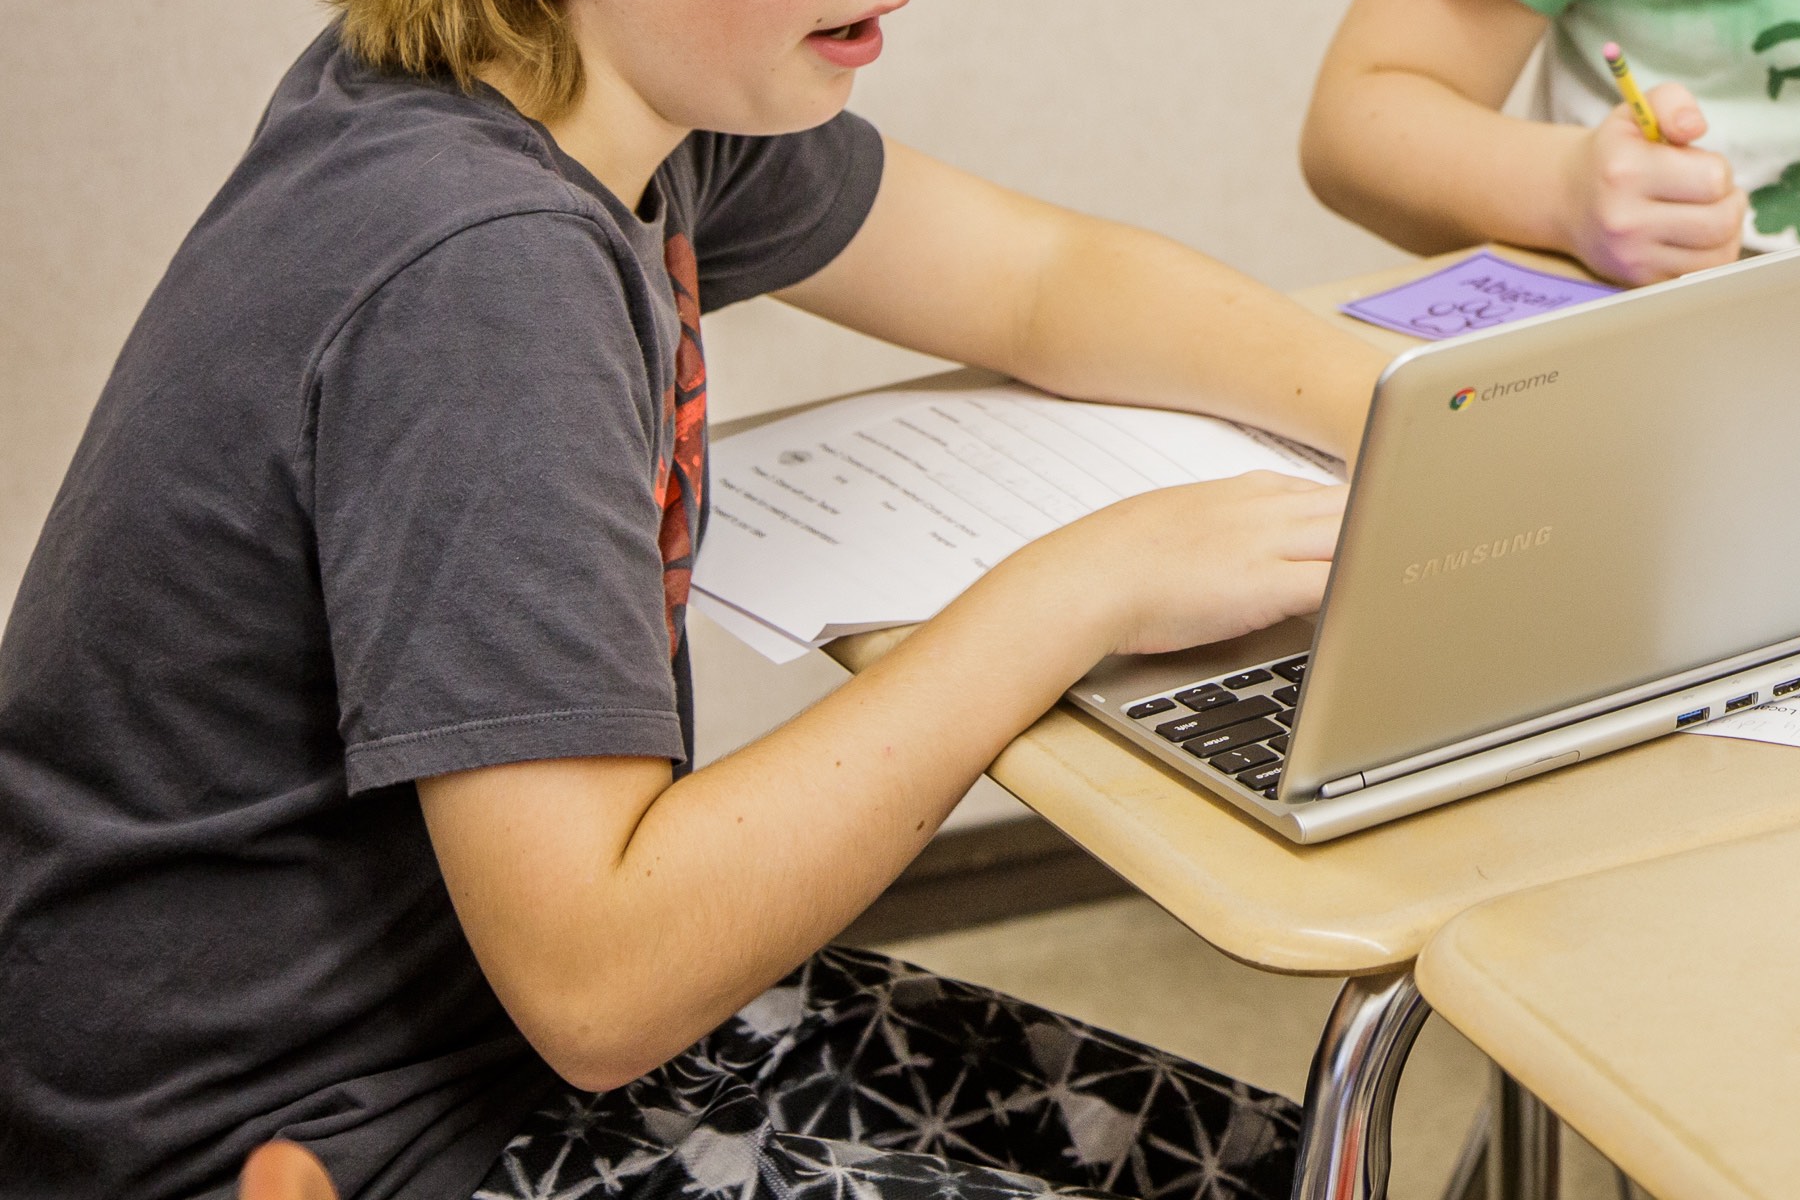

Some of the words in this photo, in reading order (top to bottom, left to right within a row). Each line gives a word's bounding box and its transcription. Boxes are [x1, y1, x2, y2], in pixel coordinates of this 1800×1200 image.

[1481, 370, 1559, 401] chrome
[1402, 525, 1552, 585] SAMSUNG
[1174, 721, 1198, 731] shift
[1203, 735, 1230, 747] enter
